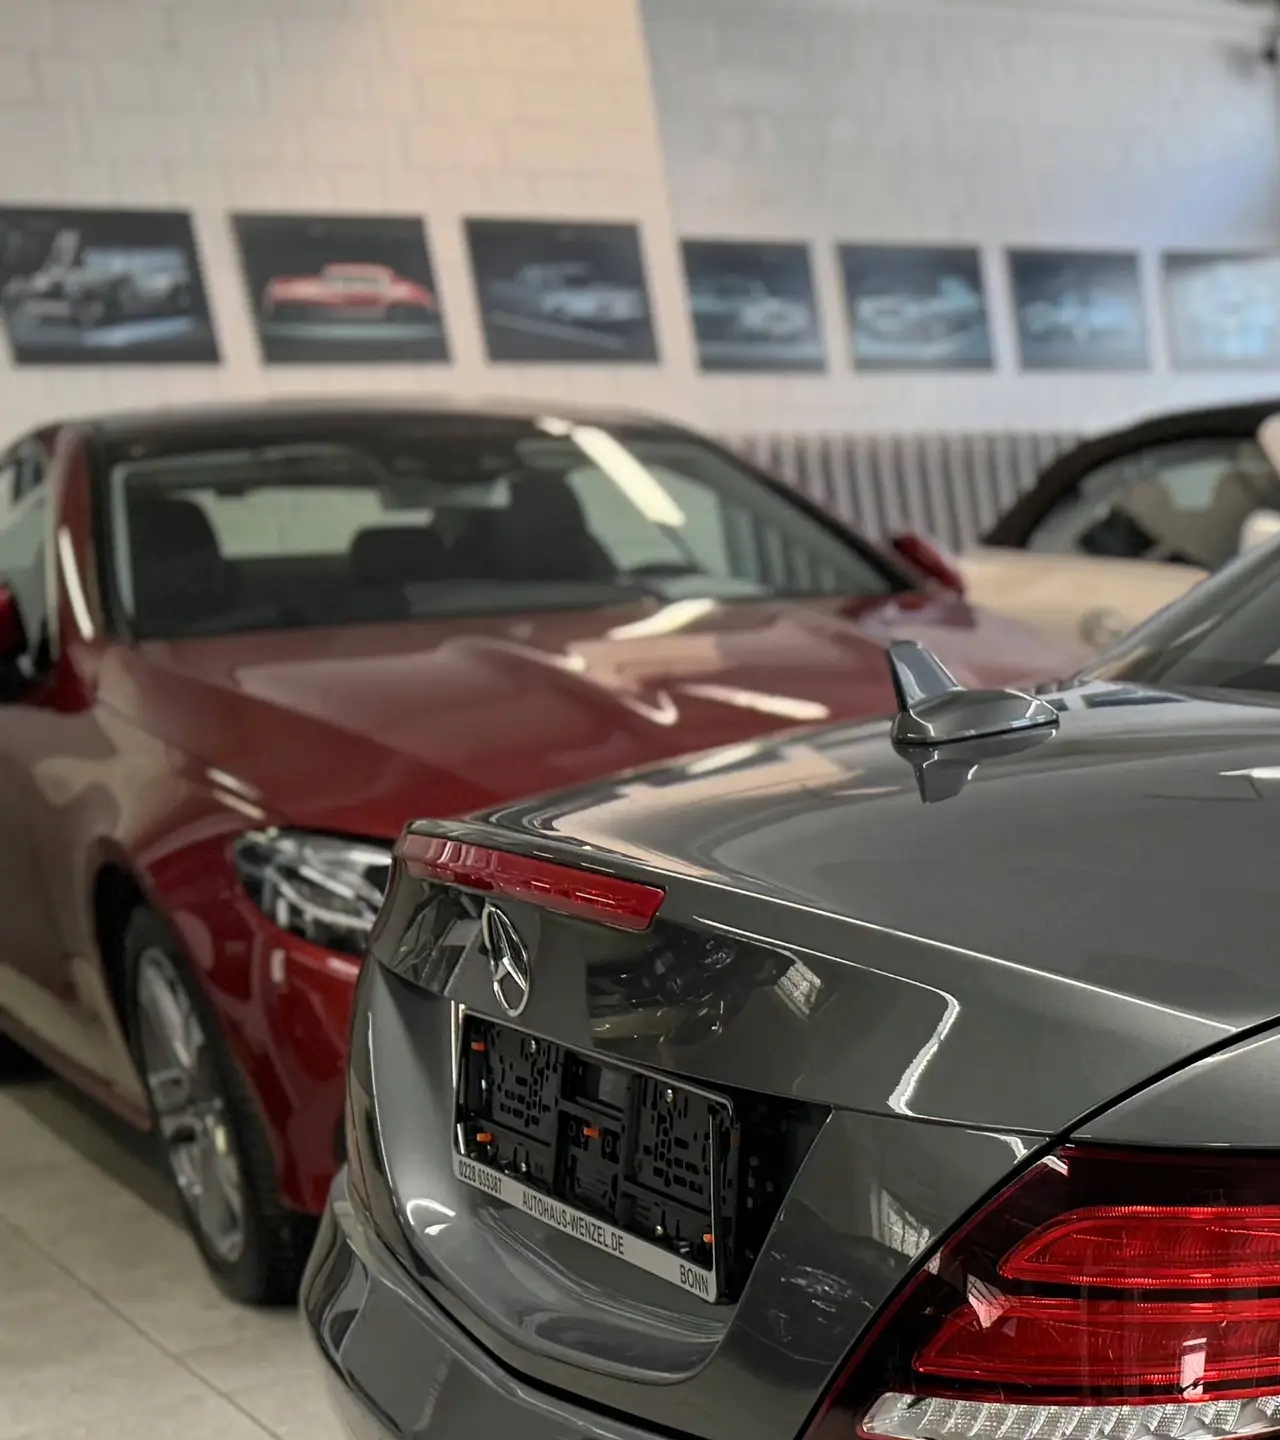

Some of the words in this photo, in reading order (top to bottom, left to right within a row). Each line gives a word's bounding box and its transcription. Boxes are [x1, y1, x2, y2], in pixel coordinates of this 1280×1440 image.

[458, 1159, 476, 1182] 0228
[522, 1191, 625, 1255] AUTOHAUS-WENZEL.DE
[679, 1264, 709, 1297] BONN
